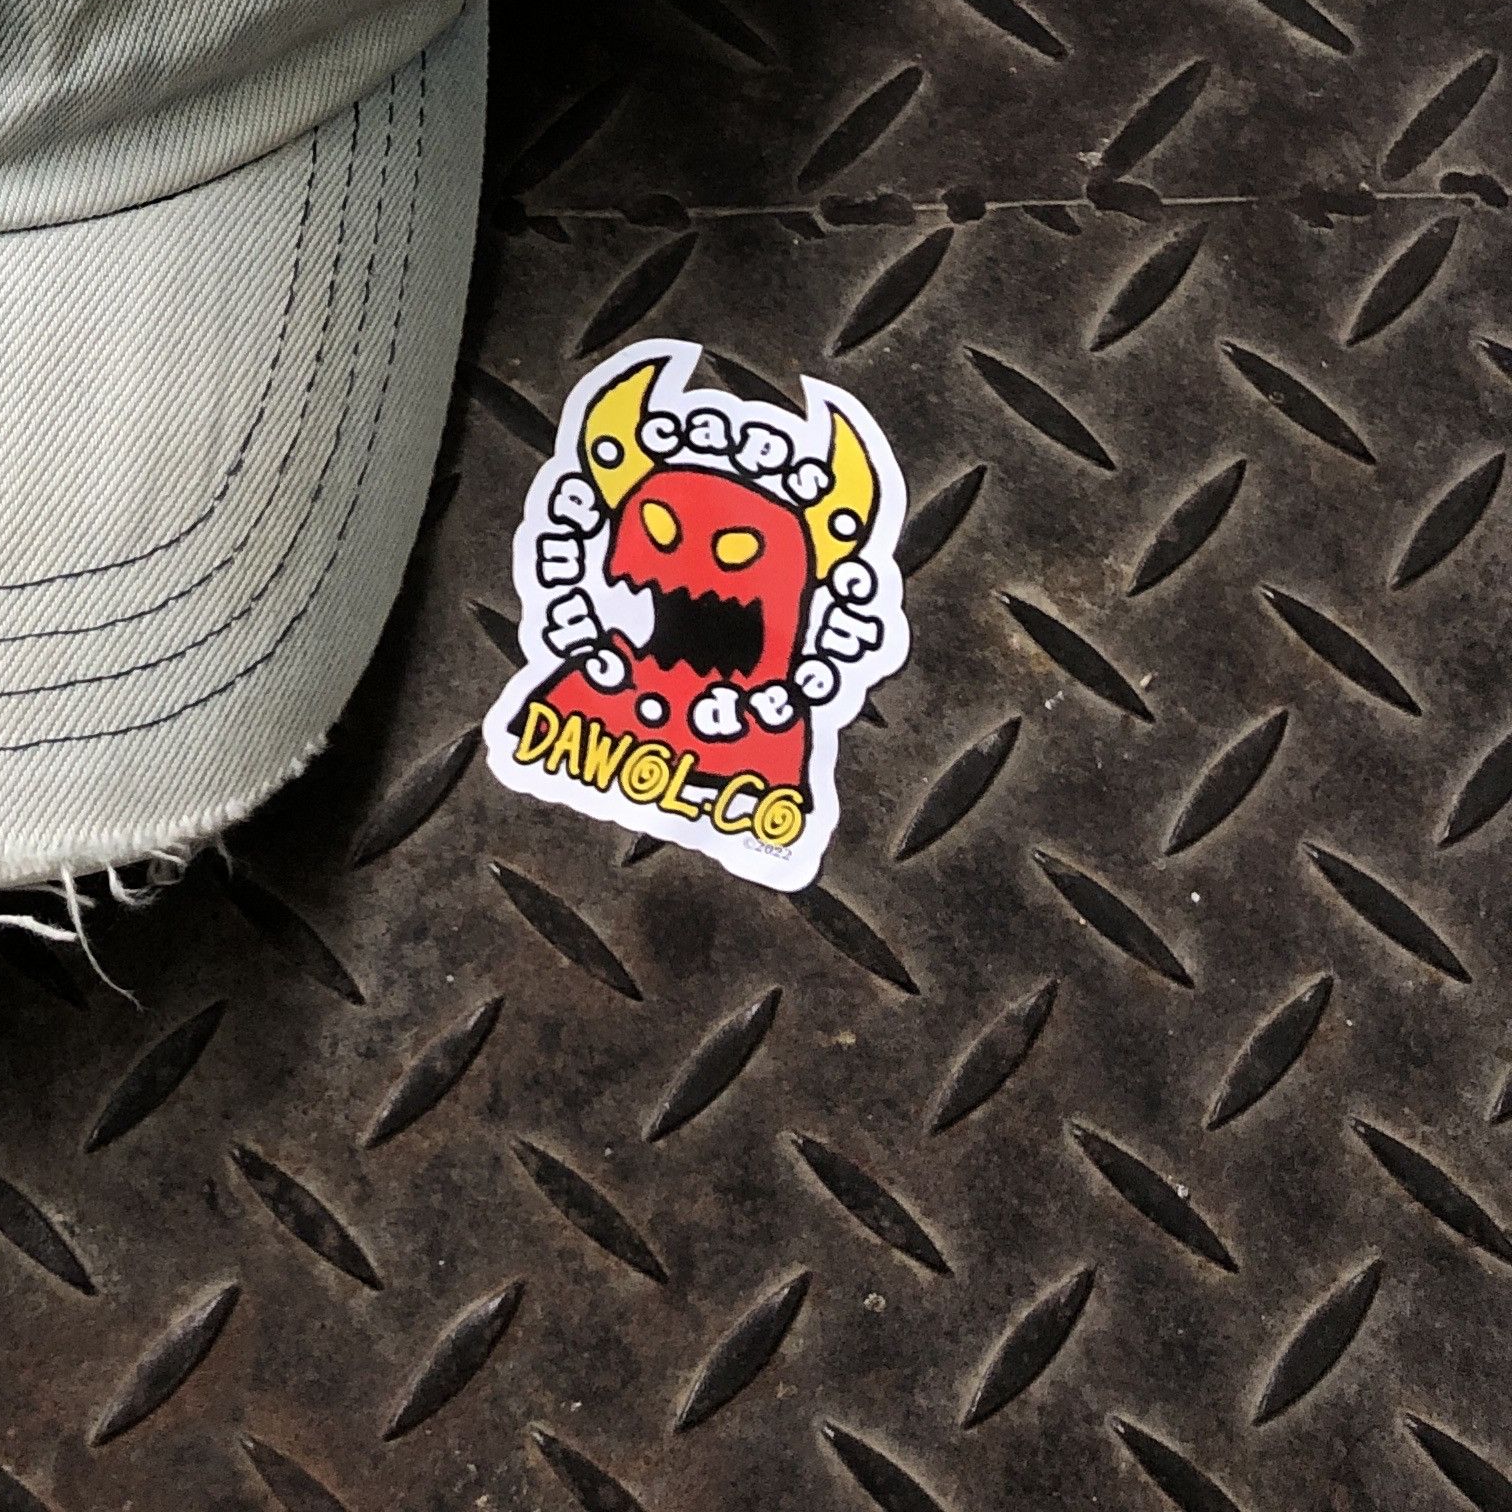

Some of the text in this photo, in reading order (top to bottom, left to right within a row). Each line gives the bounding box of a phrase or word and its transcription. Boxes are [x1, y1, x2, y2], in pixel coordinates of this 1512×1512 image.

[537, 409, 884, 739] chup caps cheap
